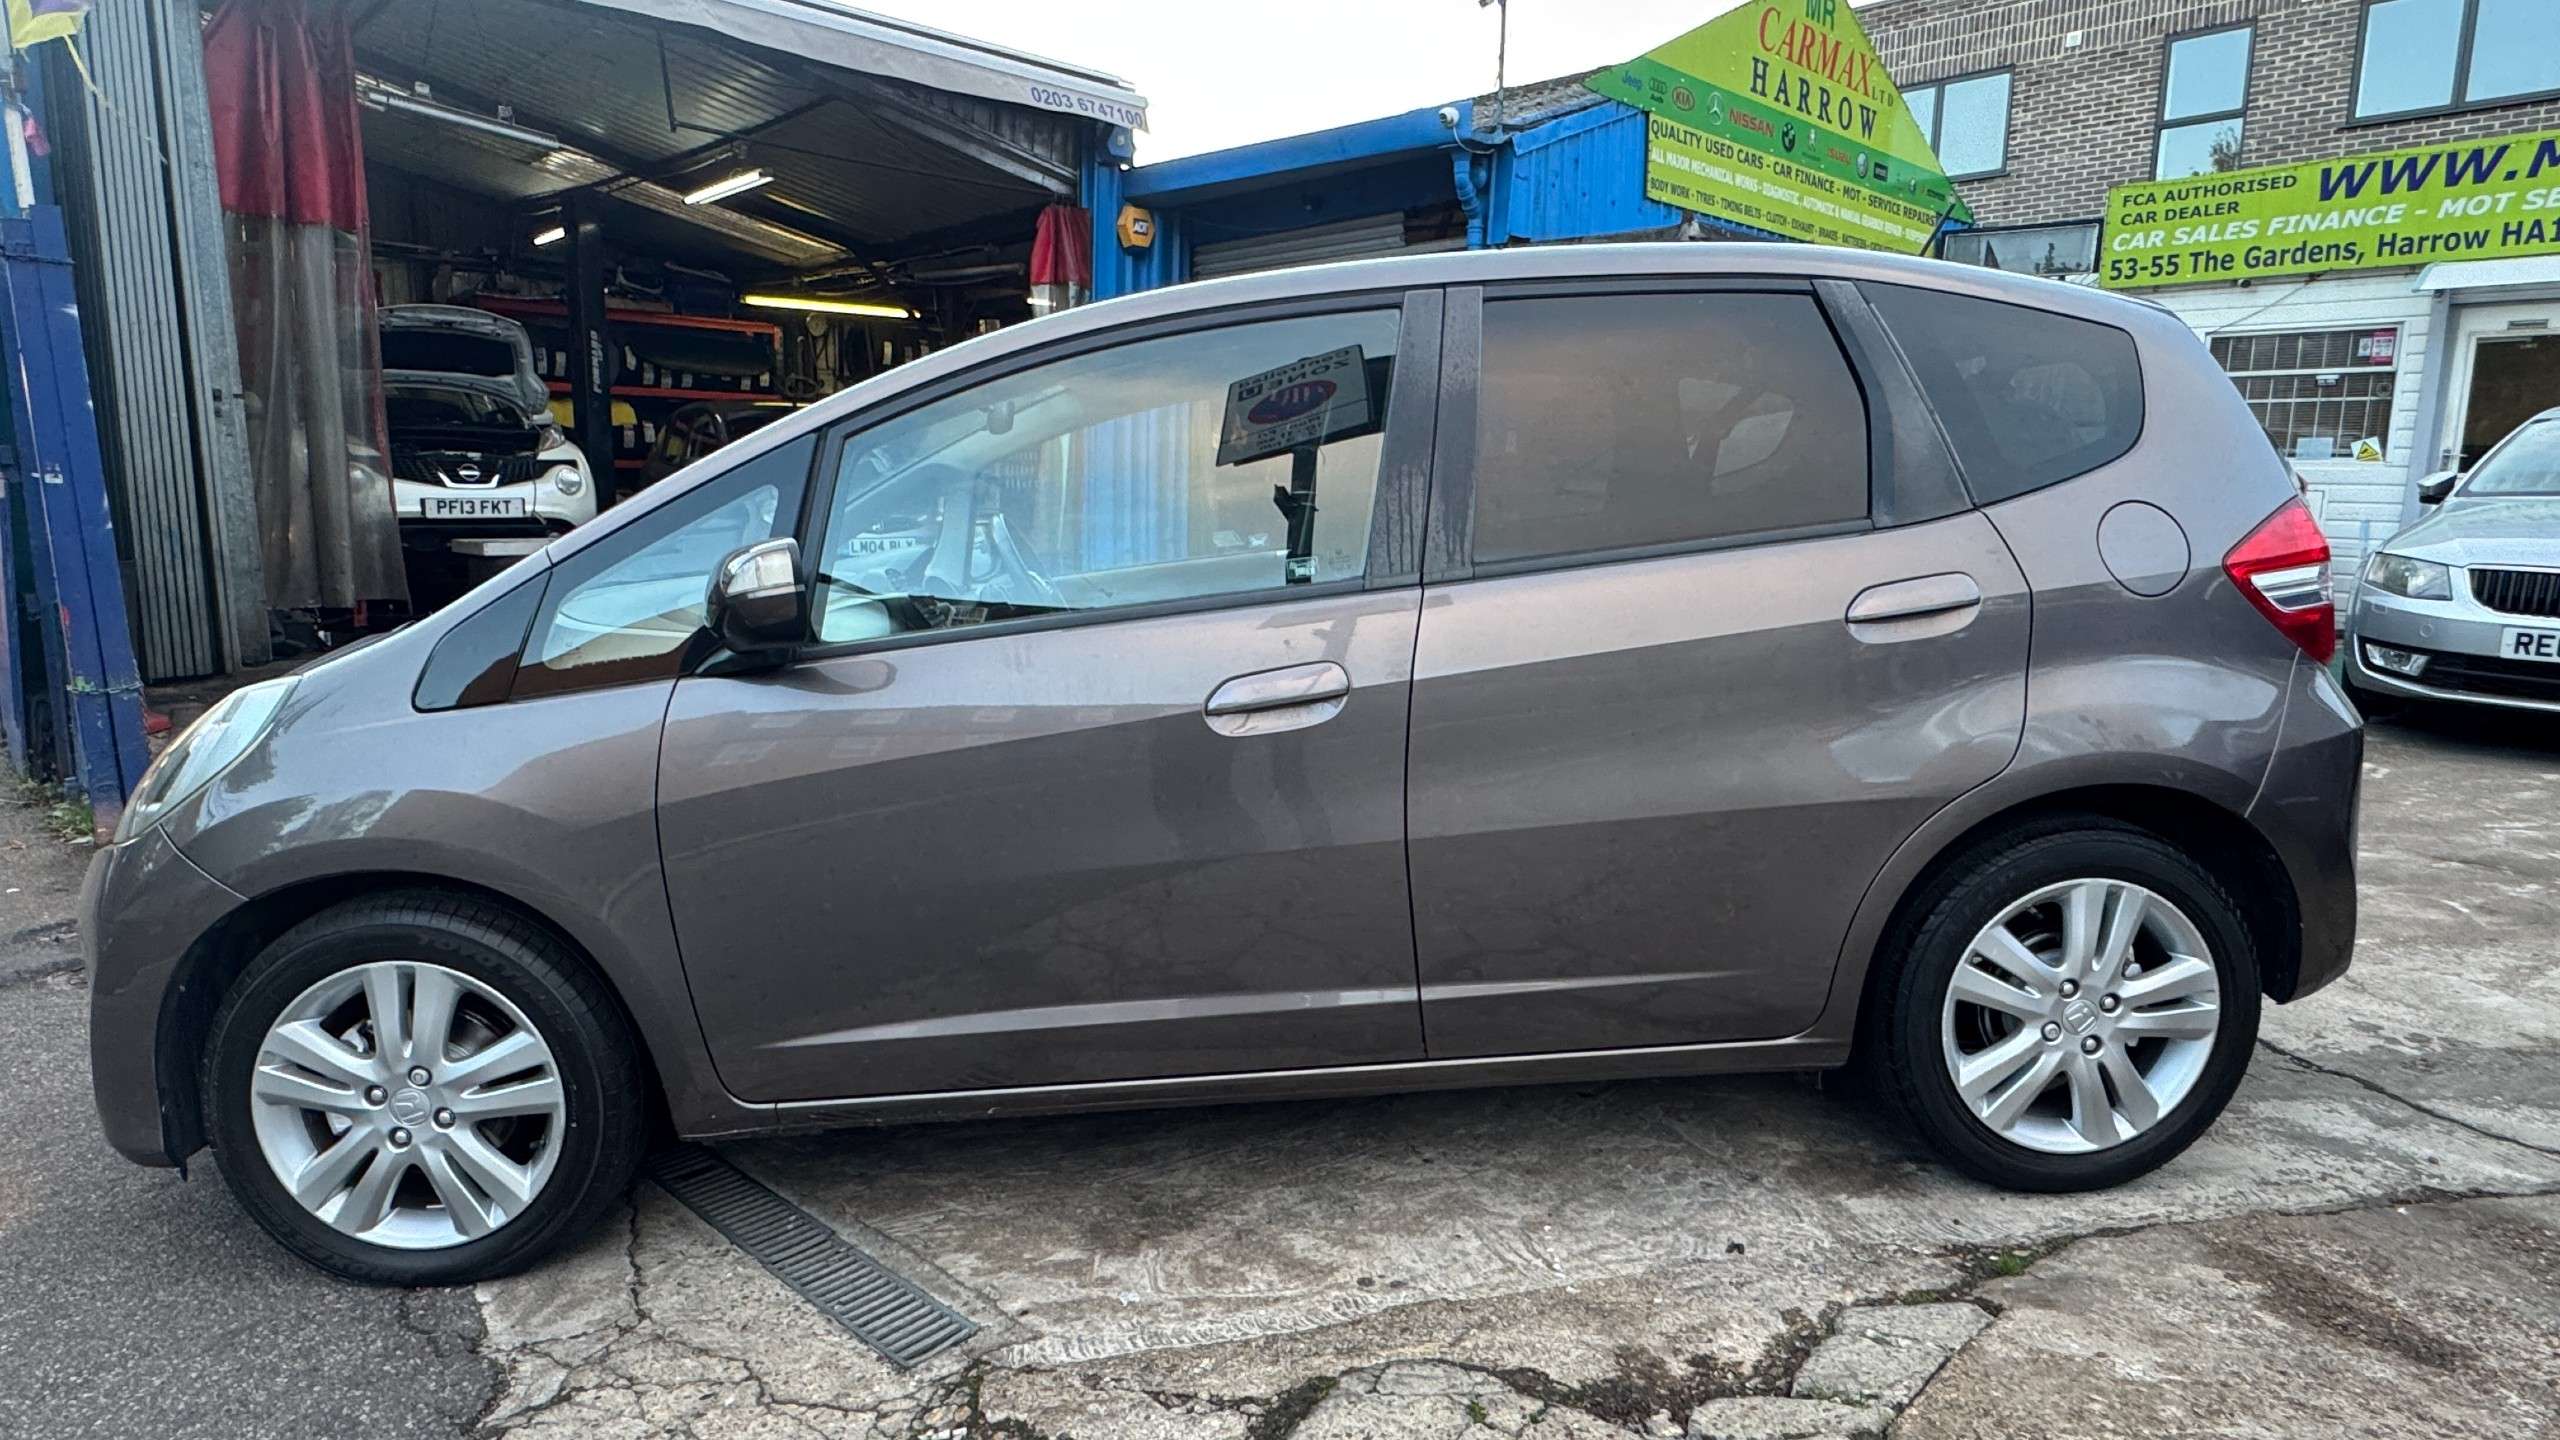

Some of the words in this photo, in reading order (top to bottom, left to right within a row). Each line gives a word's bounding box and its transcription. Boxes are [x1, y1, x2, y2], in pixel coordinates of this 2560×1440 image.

[1805, 0, 1836, 31] MR
[1760, 6, 1876, 97] CARMAX
[1872, 86, 1894, 107] LTD
[1031, 87, 1073, 109] 0203
[1078, 97, 1143, 128] 6747100
[1750, 56, 1877, 141] HARROW
[1729, 108, 1775, 138] NISSAN
[1651, 119, 1702, 149] QUALITY
[1705, 138, 1734, 160] USED
[1737, 149, 1764, 170] CARS
[1773, 161, 1792, 180] CAR
[1795, 168, 1835, 194] FINANCE
[1843, 185, 1861, 202] MOT
[1868, 194, 1901, 216] SERVICE
[1903, 205, 1936, 227] REPAIRS
[2123, 192, 2157, 208] FCA
[2163, 174, 2297, 203] AUTHORISED
[2112, 229, 2165, 251] CAR
[2171, 219, 2258, 246] SALES
[2266, 203, 2408, 237] FINANCE
[2436, 191, 2517, 219] MOT
[2120, 210, 2157, 226] CAR
[2164, 201, 2240, 221] DEALER
[2109, 253, 2180, 281] 53-55
[2189, 249, 2235, 273] The
[2244, 240, 2365, 266] Gardens,
[2377, 229, 2490, 258] Harrow
[437, 500, 475, 515] PF13
[480, 500, 511, 515] FKT
[851, 539, 885, 554] LM04
[2513, 632, 2560, 658] RE
